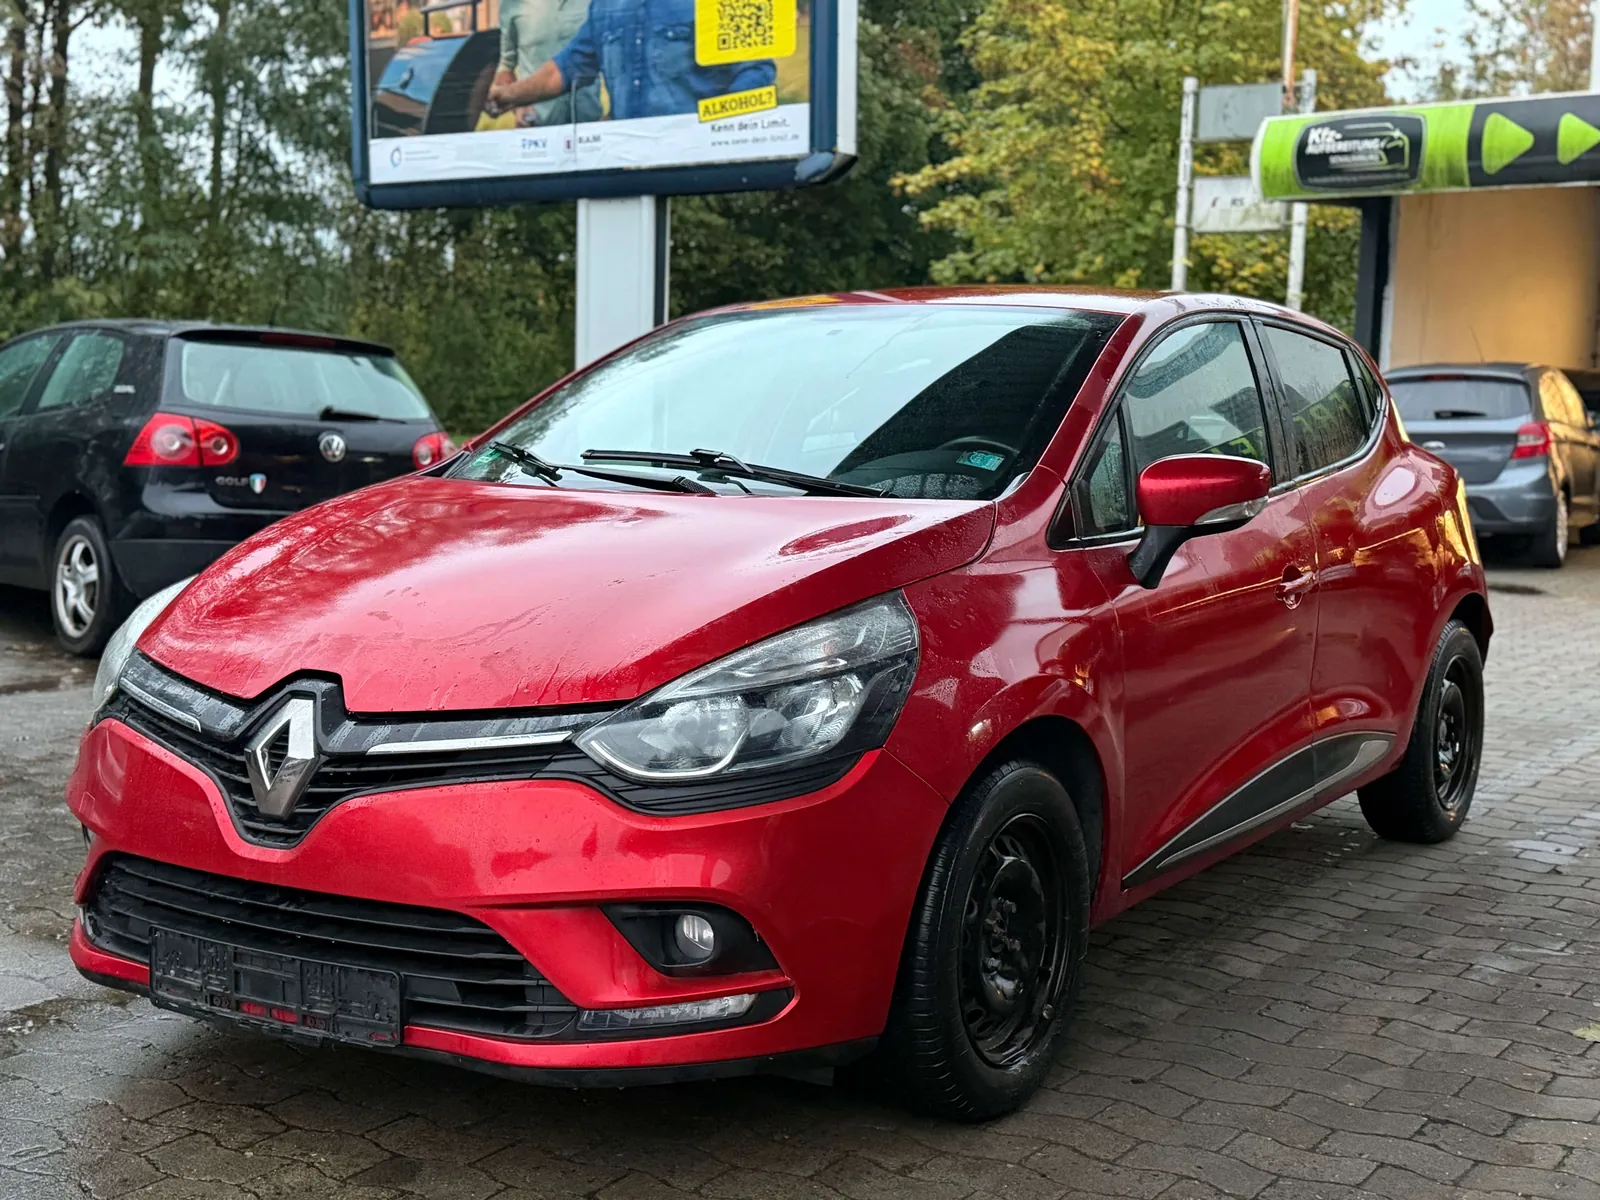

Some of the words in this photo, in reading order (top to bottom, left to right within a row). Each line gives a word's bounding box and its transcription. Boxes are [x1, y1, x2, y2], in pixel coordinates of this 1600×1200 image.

[702, 91, 773, 118] ALKOHOL?
[1308, 127, 1342, 143] Kfz-
[215, 476, 249, 486] GOLF
